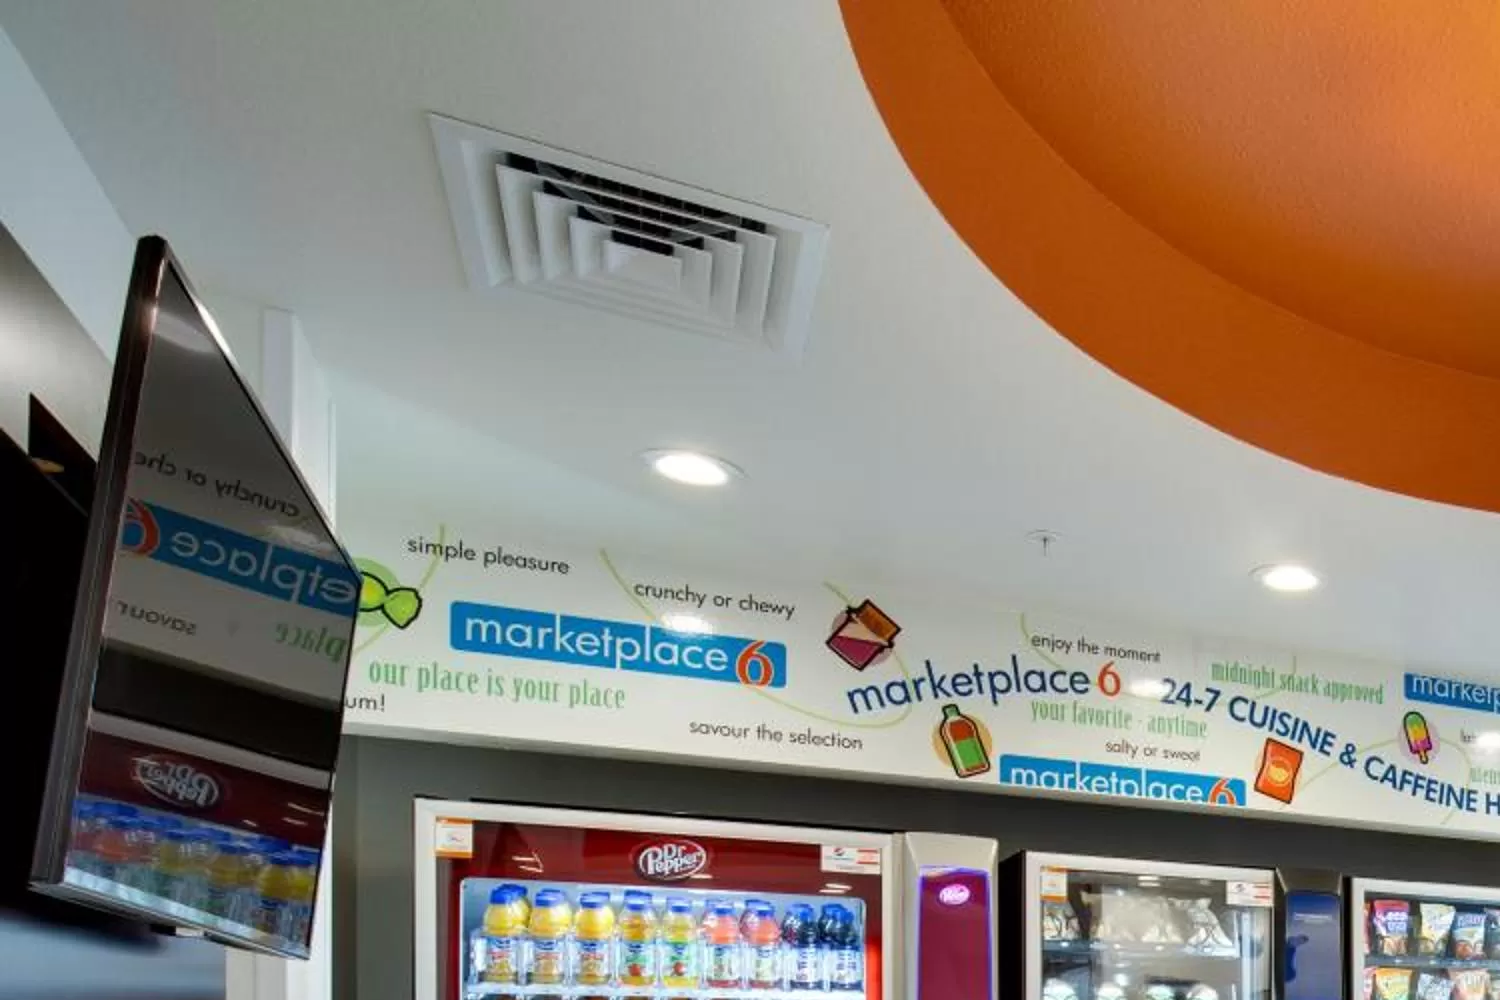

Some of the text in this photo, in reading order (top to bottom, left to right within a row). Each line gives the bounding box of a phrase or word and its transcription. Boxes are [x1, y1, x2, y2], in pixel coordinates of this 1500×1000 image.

[407, 536, 570, 575] simple pleasure
[634, 583, 796, 620] crunchy or chewy
[1030, 633, 1161, 664] enjoy the moment
[368, 659, 625, 709] our place is your place
[1210, 660, 1384, 705] midnight snack approved
[689, 720, 863, 750] savour the selection
[1030, 701, 1066, 723] your
[1072, 701, 1132, 730] favorite
[1147, 708, 1209, 739] anytime
[1105, 739, 1201, 763] salty or sweet
[1161, 677, 1222, 713] 24-7
[1227, 695, 1337, 757] CUISINE
[1339, 742, 1358, 769] &
[1363, 755, 1479, 813] CAFFEINE
[647, 843, 699, 875] Dr Pepper
